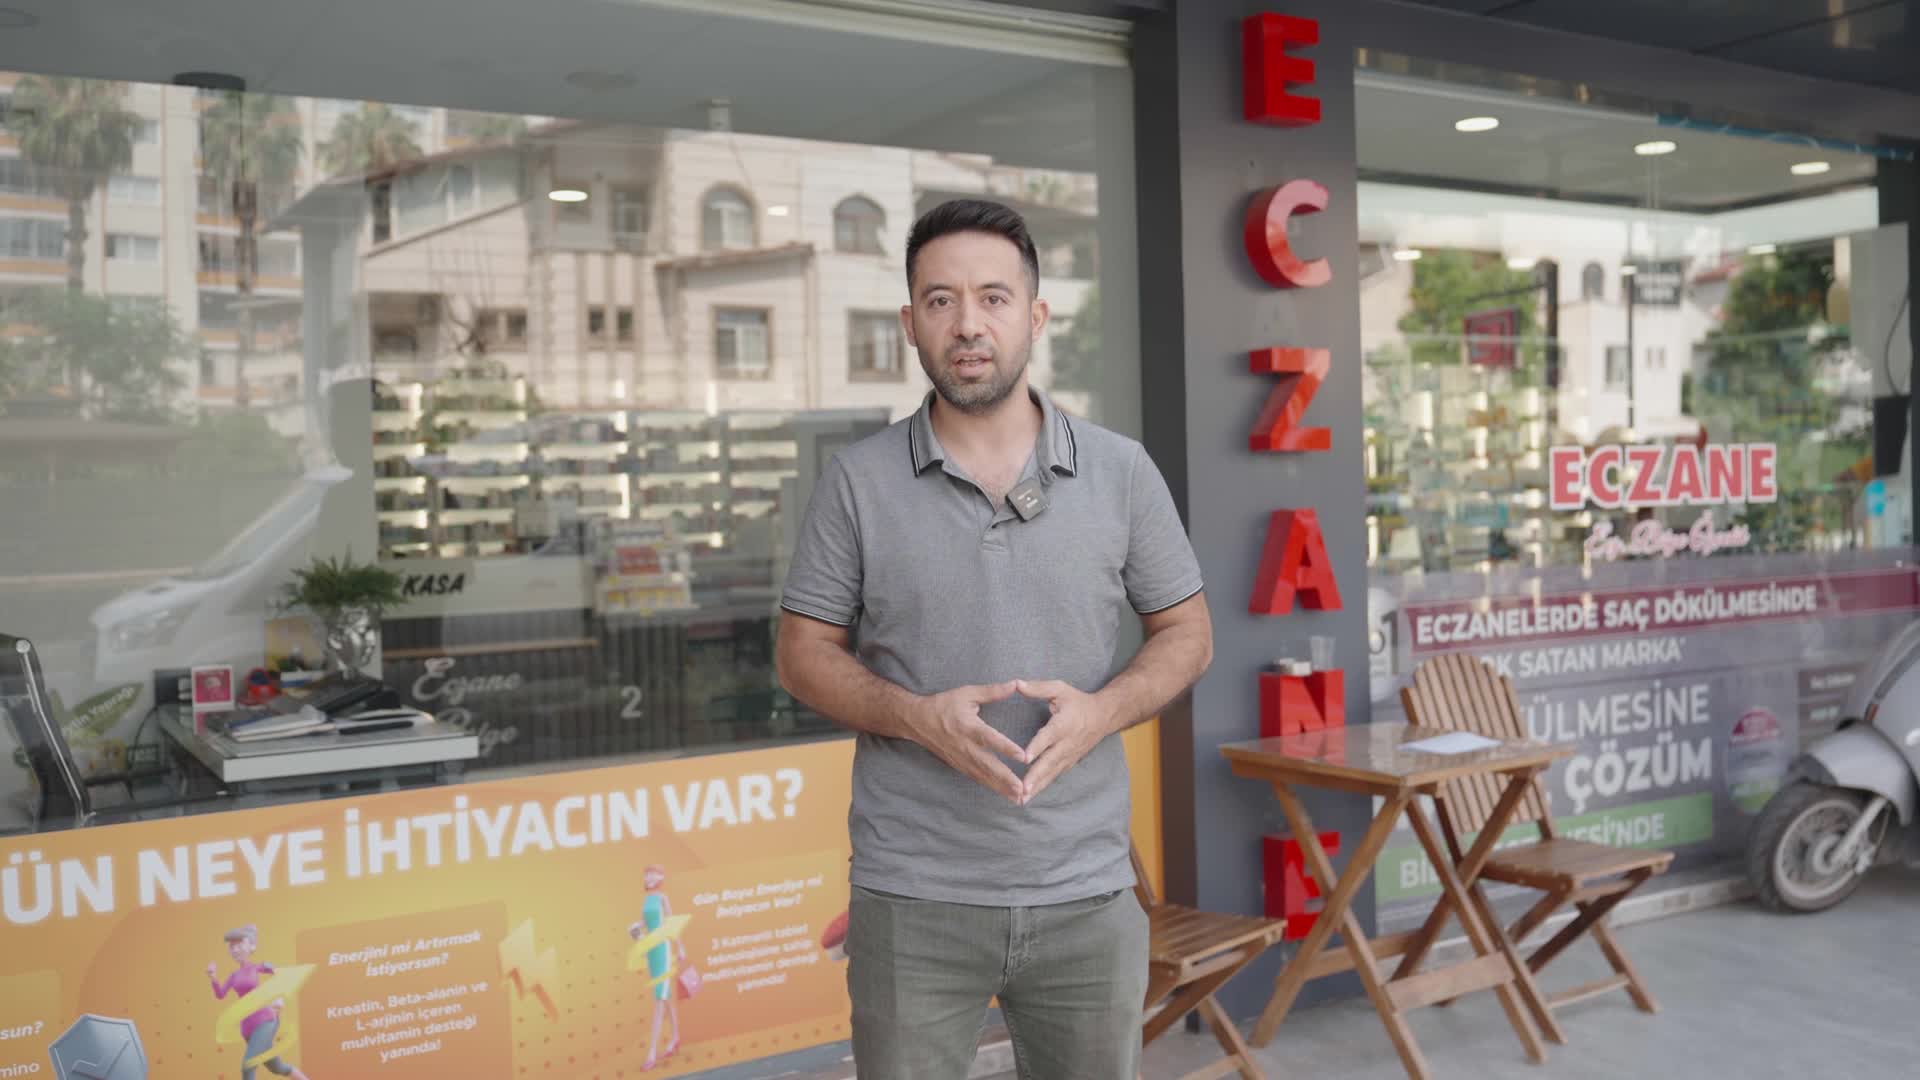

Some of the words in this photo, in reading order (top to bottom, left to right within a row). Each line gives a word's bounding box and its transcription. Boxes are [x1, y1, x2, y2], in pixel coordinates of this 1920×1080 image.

[1550, 443, 1777, 508] ECZANE
[402, 572, 464, 595] KASA
[1416, 603, 1598, 645] ECZANELERDE
[1604, 599, 1649, 632] SAÇ
[1655, 580, 1817, 623] DÖKÜLMESİNDE
[1518, 643, 1602, 678] SATAN
[620, 686, 643, 719] 2
[1521, 679, 1710, 742] ÜLMESİNE
[1565, 731, 1713, 815] ÇÖZÜM
[1, 850, 115, 926] ÜN
[138, 829, 325, 906] NEYE
[345, 788, 650, 878] İHTİYACIN
[661, 768, 804, 833] VAR?
[328, 944, 388, 967] Enerjini
[392, 938, 411, 955] mi
[415, 930, 482, 952] Artırmak
[366, 952, 449, 977] İstiyorsun?
[327, 1000, 385, 1019] Kreatin,
[388, 983, 467, 1008] Beta-alanin
[471, 981, 488, 993] ve
[356, 1011, 414, 1032] L-arjinin
[418, 1002, 462, 1020] içeren
[424, 1014, 477, 1035] desteği
[380, 1039, 441, 1064] yanında!
